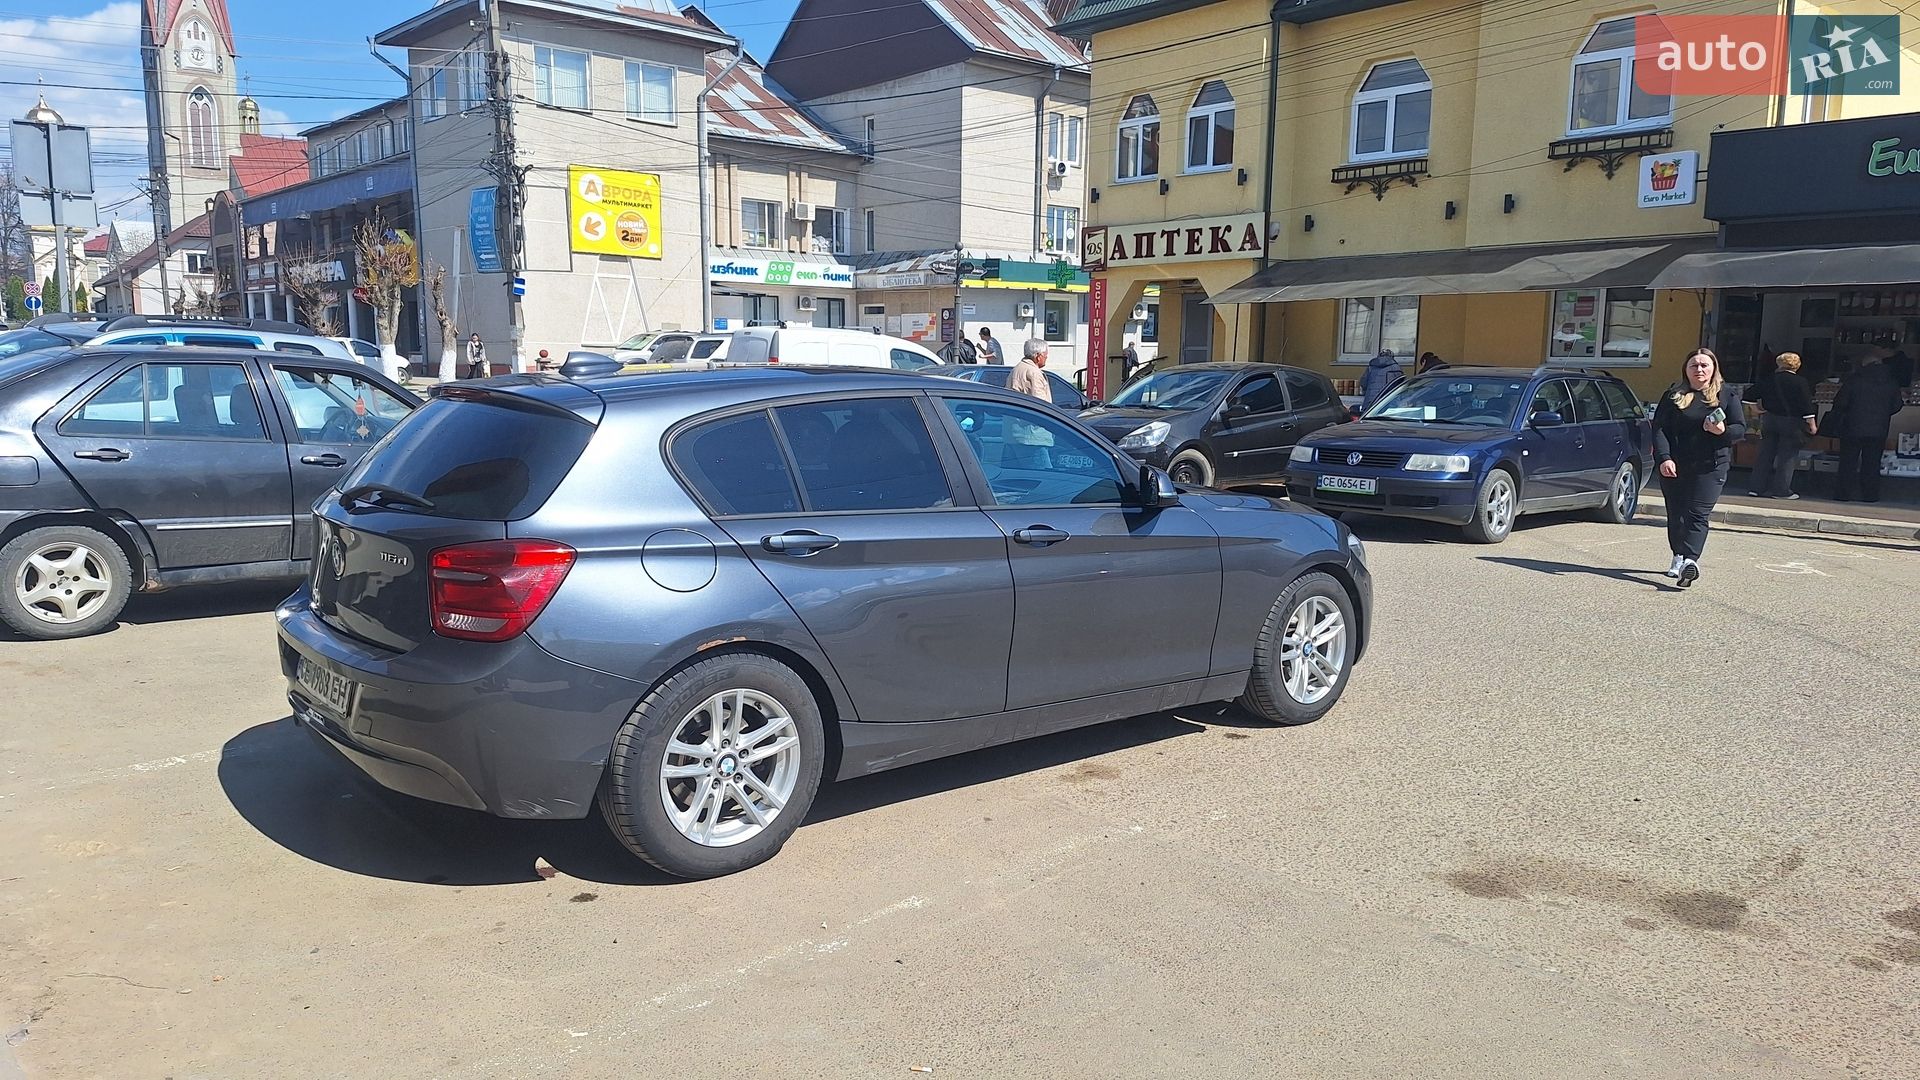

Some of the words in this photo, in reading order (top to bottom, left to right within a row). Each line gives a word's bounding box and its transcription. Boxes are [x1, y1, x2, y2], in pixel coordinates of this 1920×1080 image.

[1868, 137, 1920, 176] Eu
[585, 179, 652, 203] АВРОРА
[1643, 194, 1660, 203] Euro
[1661, 191, 1687, 201] Market
[601, 198, 653, 209] МУЛЬТИМАРКЕТ
[617, 219, 645, 229] НОВИЙ
[621, 229, 630, 241] 2
[1109, 222, 1262, 261] АПТЕКА
[1093, 281, 1102, 336] SCHIMB
[1323, 477, 1336, 488] CE
[1337, 478, 1358, 489] 0654
[330, 676, 348, 709] EH
